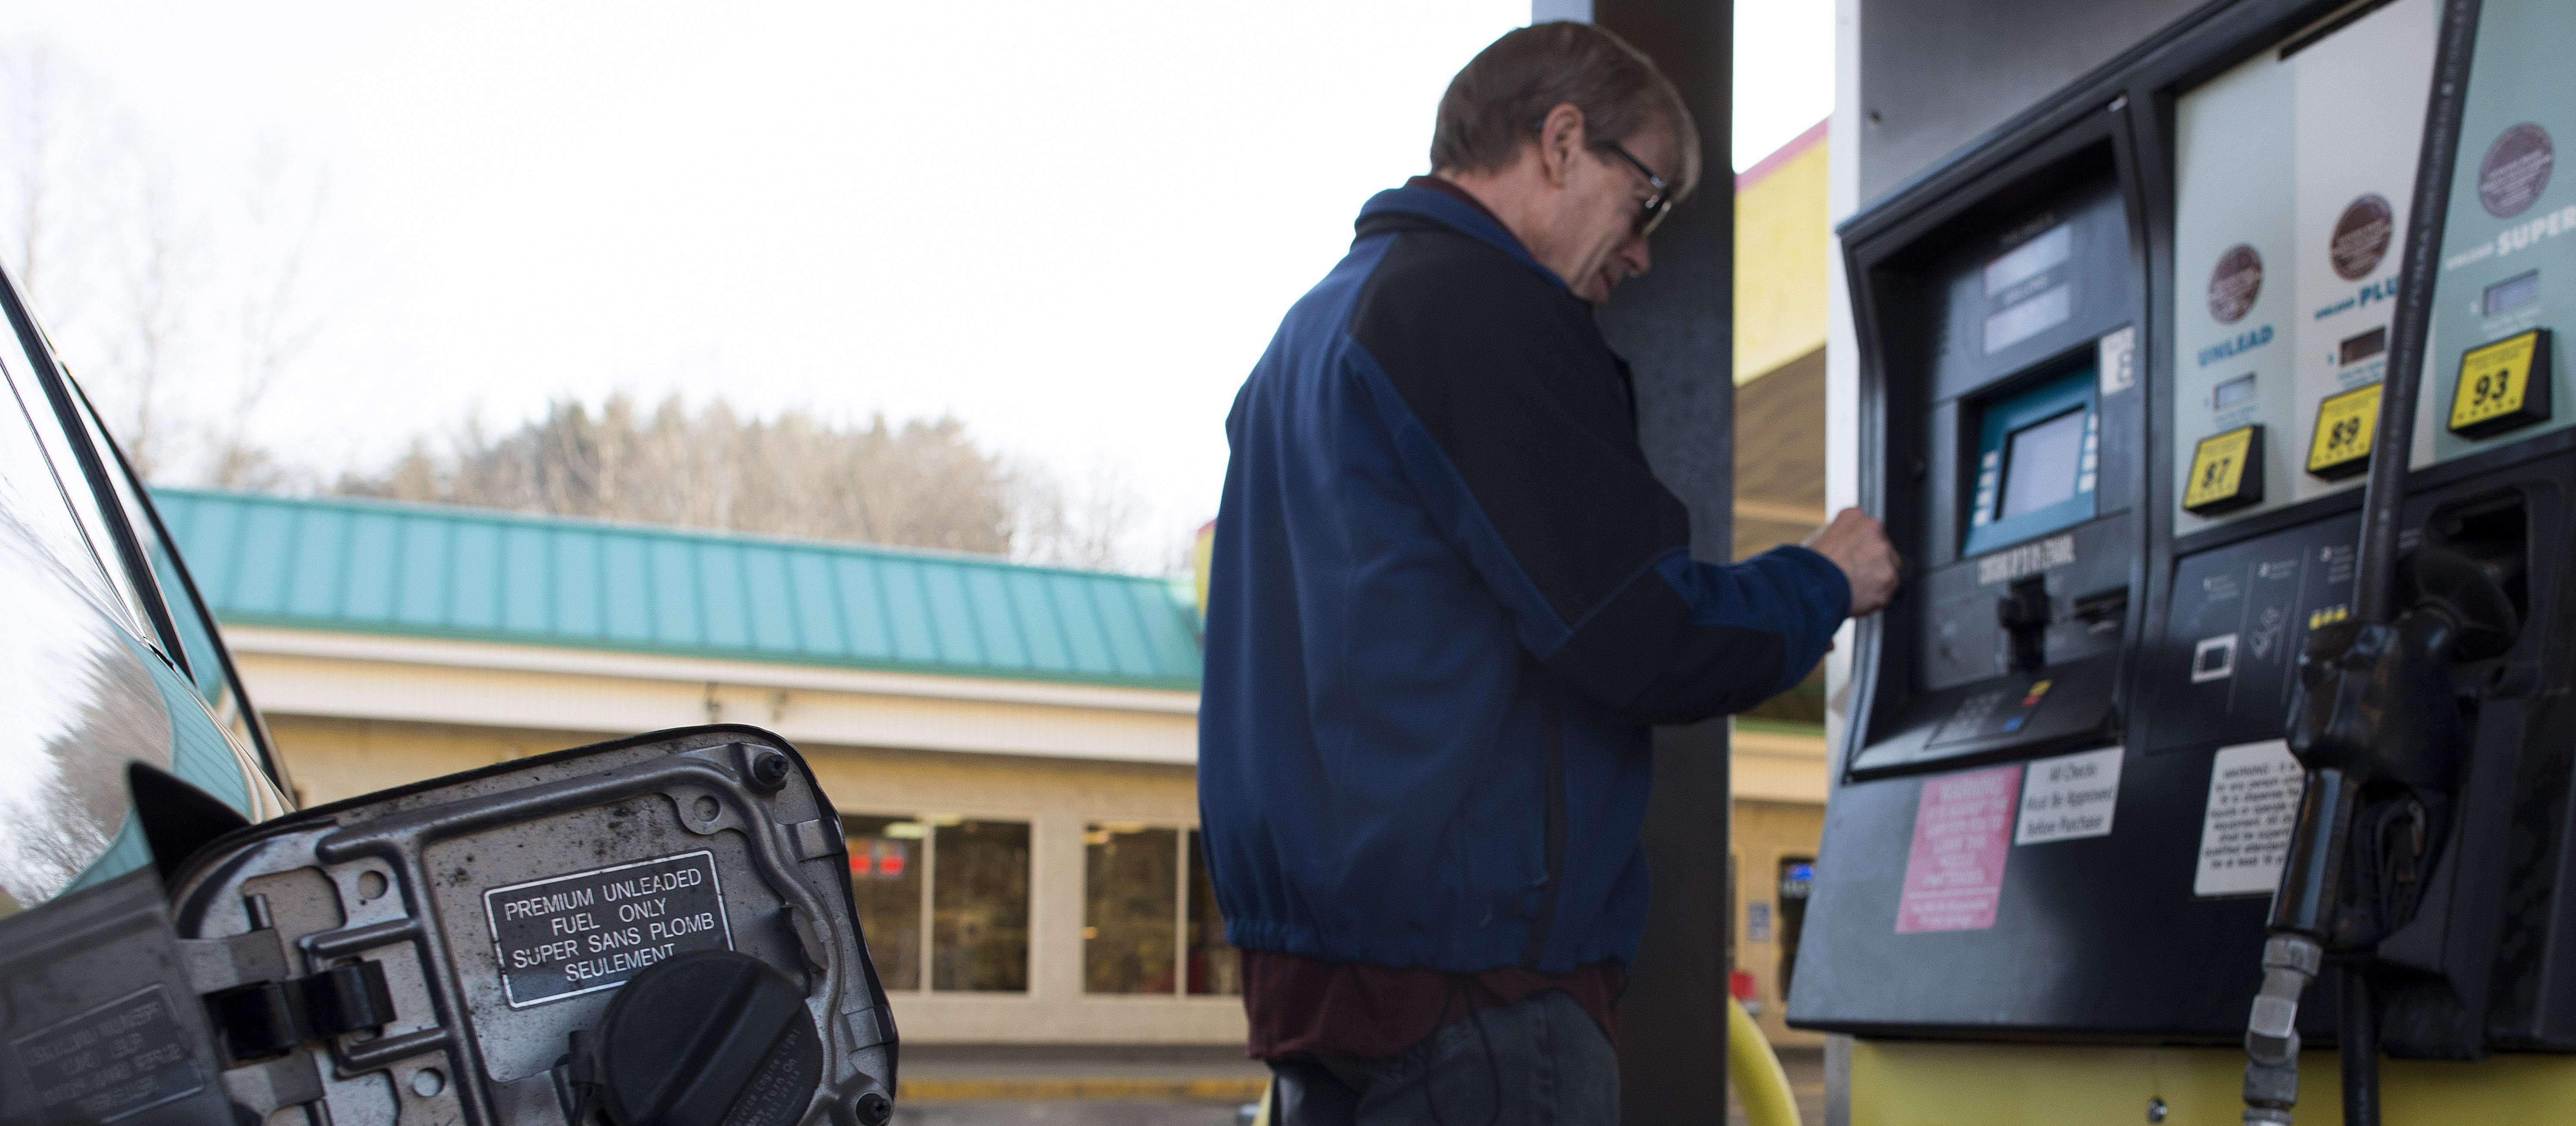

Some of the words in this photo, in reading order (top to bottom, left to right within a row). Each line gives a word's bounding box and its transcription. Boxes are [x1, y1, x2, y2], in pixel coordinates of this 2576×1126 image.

[2498, 204, 2576, 256] SUPER
[2359, 275, 2402, 306] PLU
[2198, 325, 2274, 367] UNLEAD
[2473, 369, 2509, 405] 93
[2328, 416, 2360, 450] 89
[2203, 458, 2232, 488] 87
[2060, 814, 2104, 832] Purchase
[505, 888, 595, 922] PREMIUM
[603, 869, 702, 902] UNLEADED
[551, 912, 600, 936] FUEL
[619, 897, 667, 922] ONLY
[512, 939, 579, 968] SUPER
[588, 927, 641, 953] SANS
[650, 913, 715, 941] PLOMB
[565, 943, 676, 982] SEULEMENT
[730, 1094, 758, 1126] ervice
[754, 1058, 781, 1091] Engine
[778, 1029, 801, 1056] Light
[762, 1077, 785, 1102] Turn
[782, 1059, 797, 1073] On
